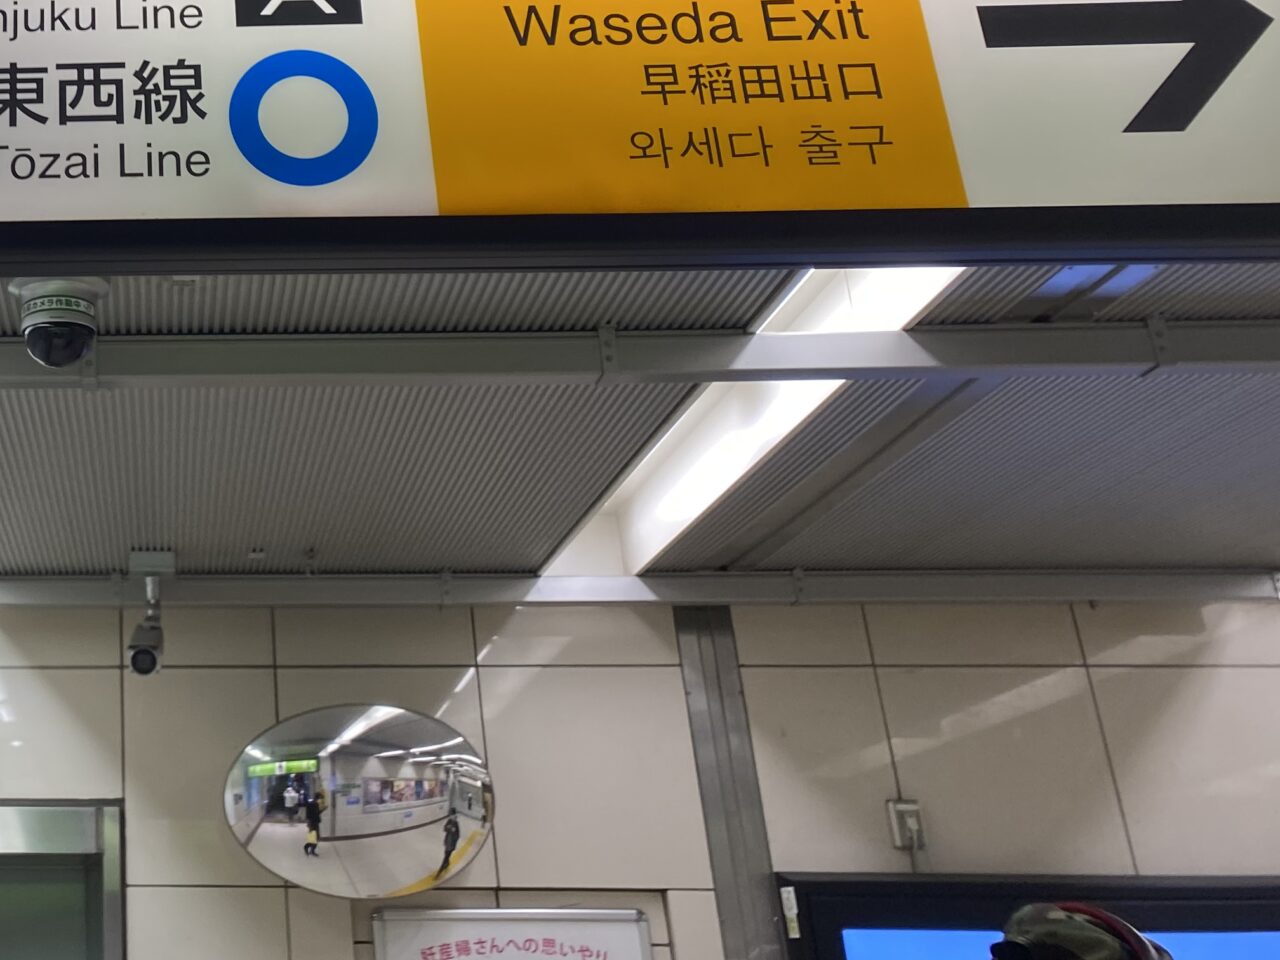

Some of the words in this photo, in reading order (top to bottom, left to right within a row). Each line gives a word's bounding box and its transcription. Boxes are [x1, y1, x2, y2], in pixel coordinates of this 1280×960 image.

[503, 0, 743, 47] Waseda
[118, 141, 211, 178] Line
[628, 125, 774, 169] 와세다
[797, 124, 894, 166] 출구
